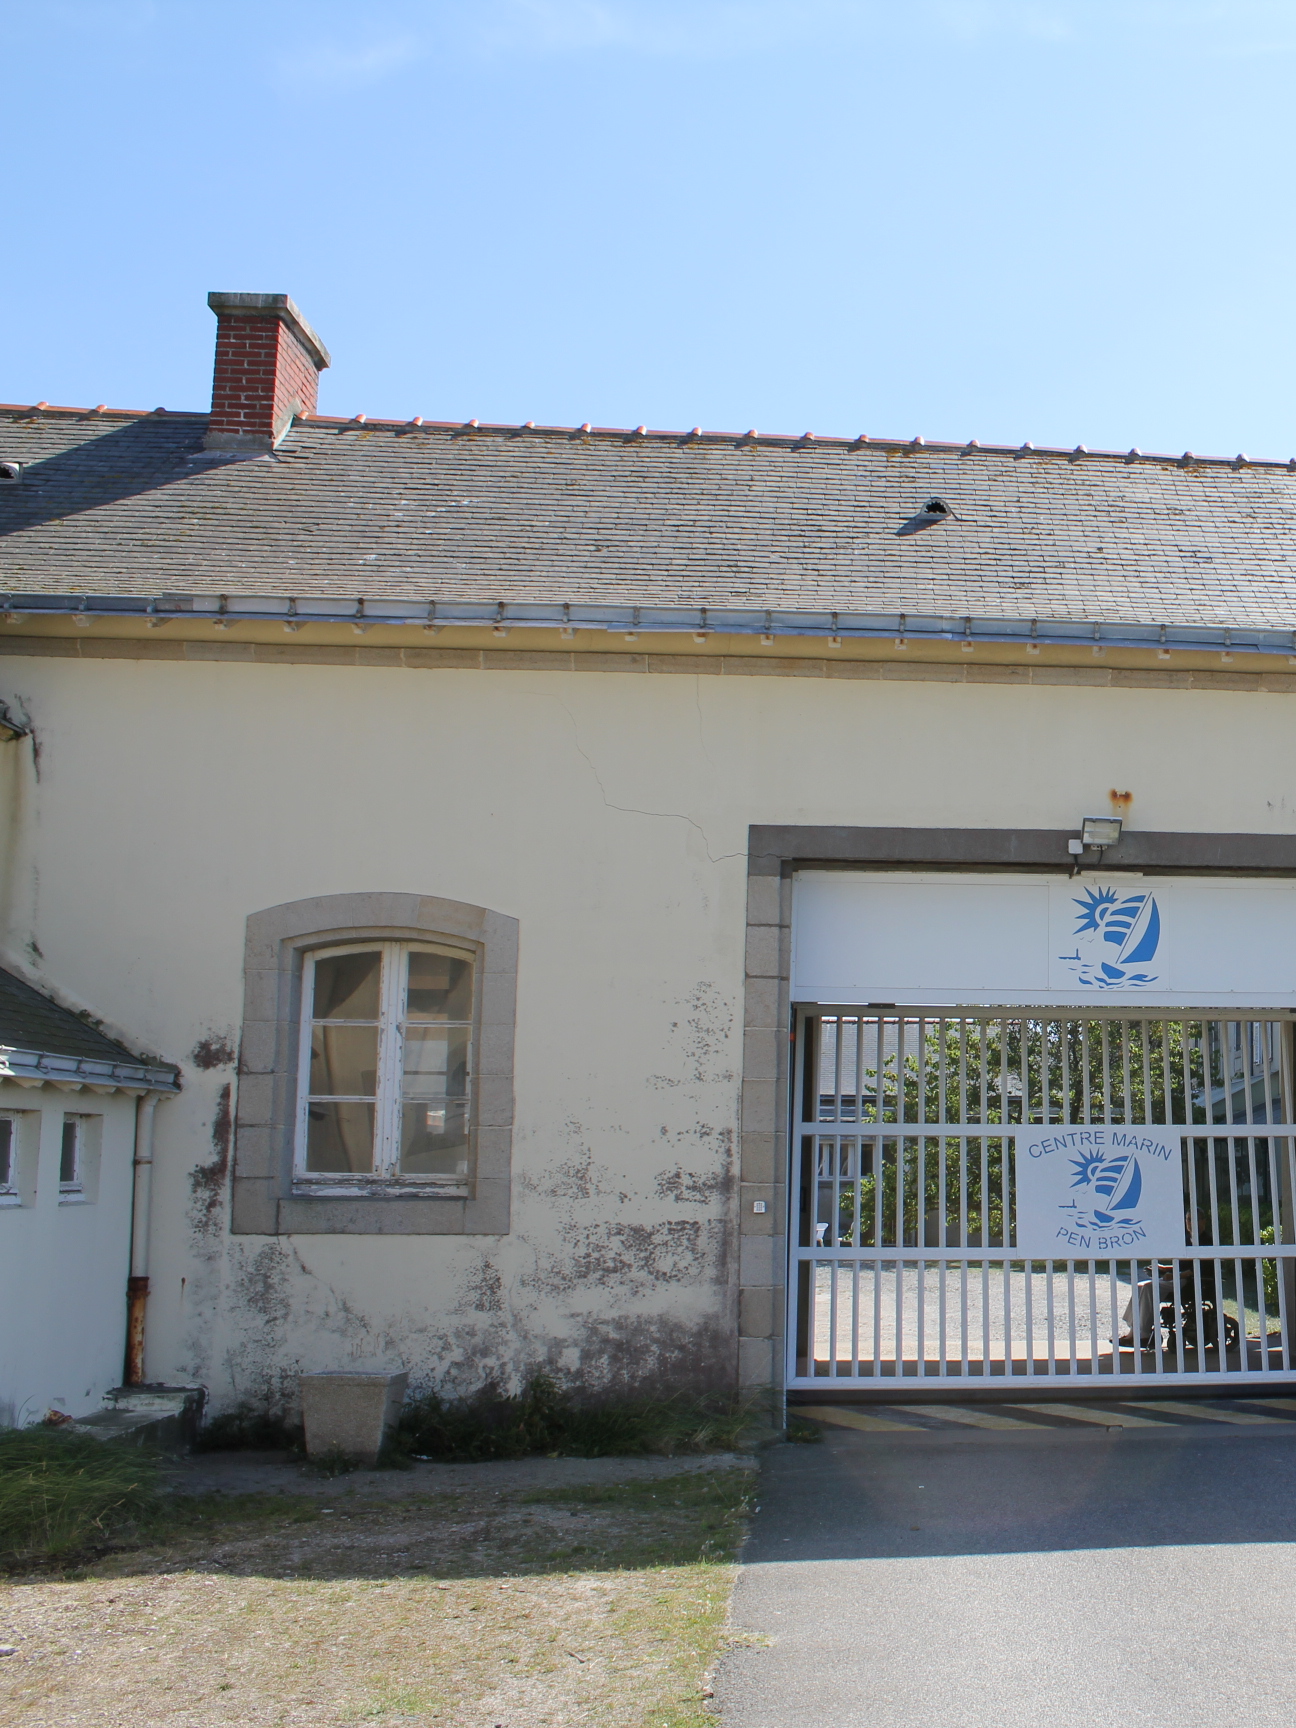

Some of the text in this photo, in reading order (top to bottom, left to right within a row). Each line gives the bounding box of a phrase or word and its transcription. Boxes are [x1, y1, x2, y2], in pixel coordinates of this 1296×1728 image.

[1028, 1131, 1172, 1161] CENTRE MARIN
[1056, 1226, 1147, 1250] PEN BRON
